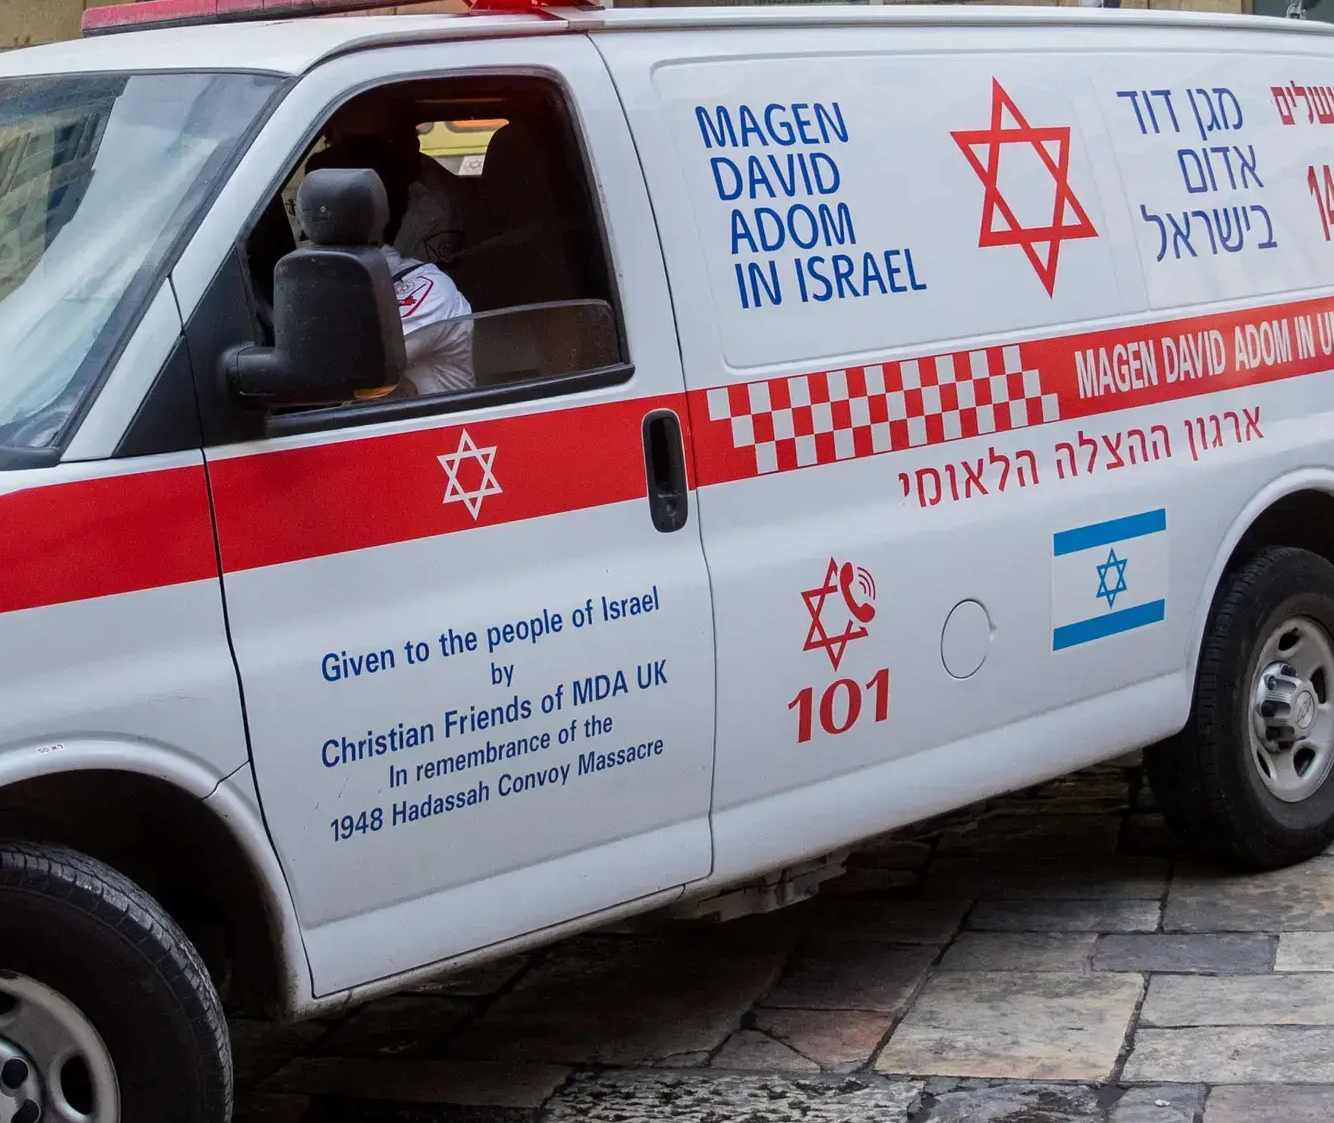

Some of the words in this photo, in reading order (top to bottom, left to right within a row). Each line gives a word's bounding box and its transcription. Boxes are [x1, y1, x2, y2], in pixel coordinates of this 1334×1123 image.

[695, 102, 849, 148] MAGEN
[1116, 89, 1180, 134] דוד
[1186, 87, 1243, 141] מגן
[710, 152, 841, 200] DAVID
[1177, 145, 1264, 193] אדום
[731, 202, 856, 255] ADOM
[1140, 204, 1278, 262] בישראל
[734, 260, 782, 309] IN
[794, 248, 927, 302] ISRAEL
[1075, 340, 1158, 398] MAGEN
[1161, 330, 1226, 384] DAVID
[1234, 319, 1293, 370] ADOM
[1295, 315, 1316, 359] IN
[1055, 424, 1171, 479] ההצלה
[1184, 406, 1264, 461] ארגון
[898, 447, 1040, 508] הלאומי
[321, 648, 395, 682] Given
[405, 641, 429, 666] to
[439, 629, 478, 657] the
[487, 608, 563, 652] people
[572, 599, 593, 628] of
[602, 585, 660, 622] Israel
[491, 662, 514, 687] by
[321, 722, 434, 768] Christian
[445, 695, 532, 738] Friends
[541, 684, 563, 715] of
[572, 670, 629, 706] MDA
[637, 659, 668, 690] UK
[787, 667, 891, 743] 101
[389, 765, 407, 788] In
[417, 732, 550, 782] remembrance
[559, 720, 577, 745] of
[584, 714, 613, 739] the
[330, 808, 383, 842] 1948
[392, 780, 489, 826] Hadassah
[498, 763, 570, 797] Convoy
[578, 738, 663, 776] Massacre
